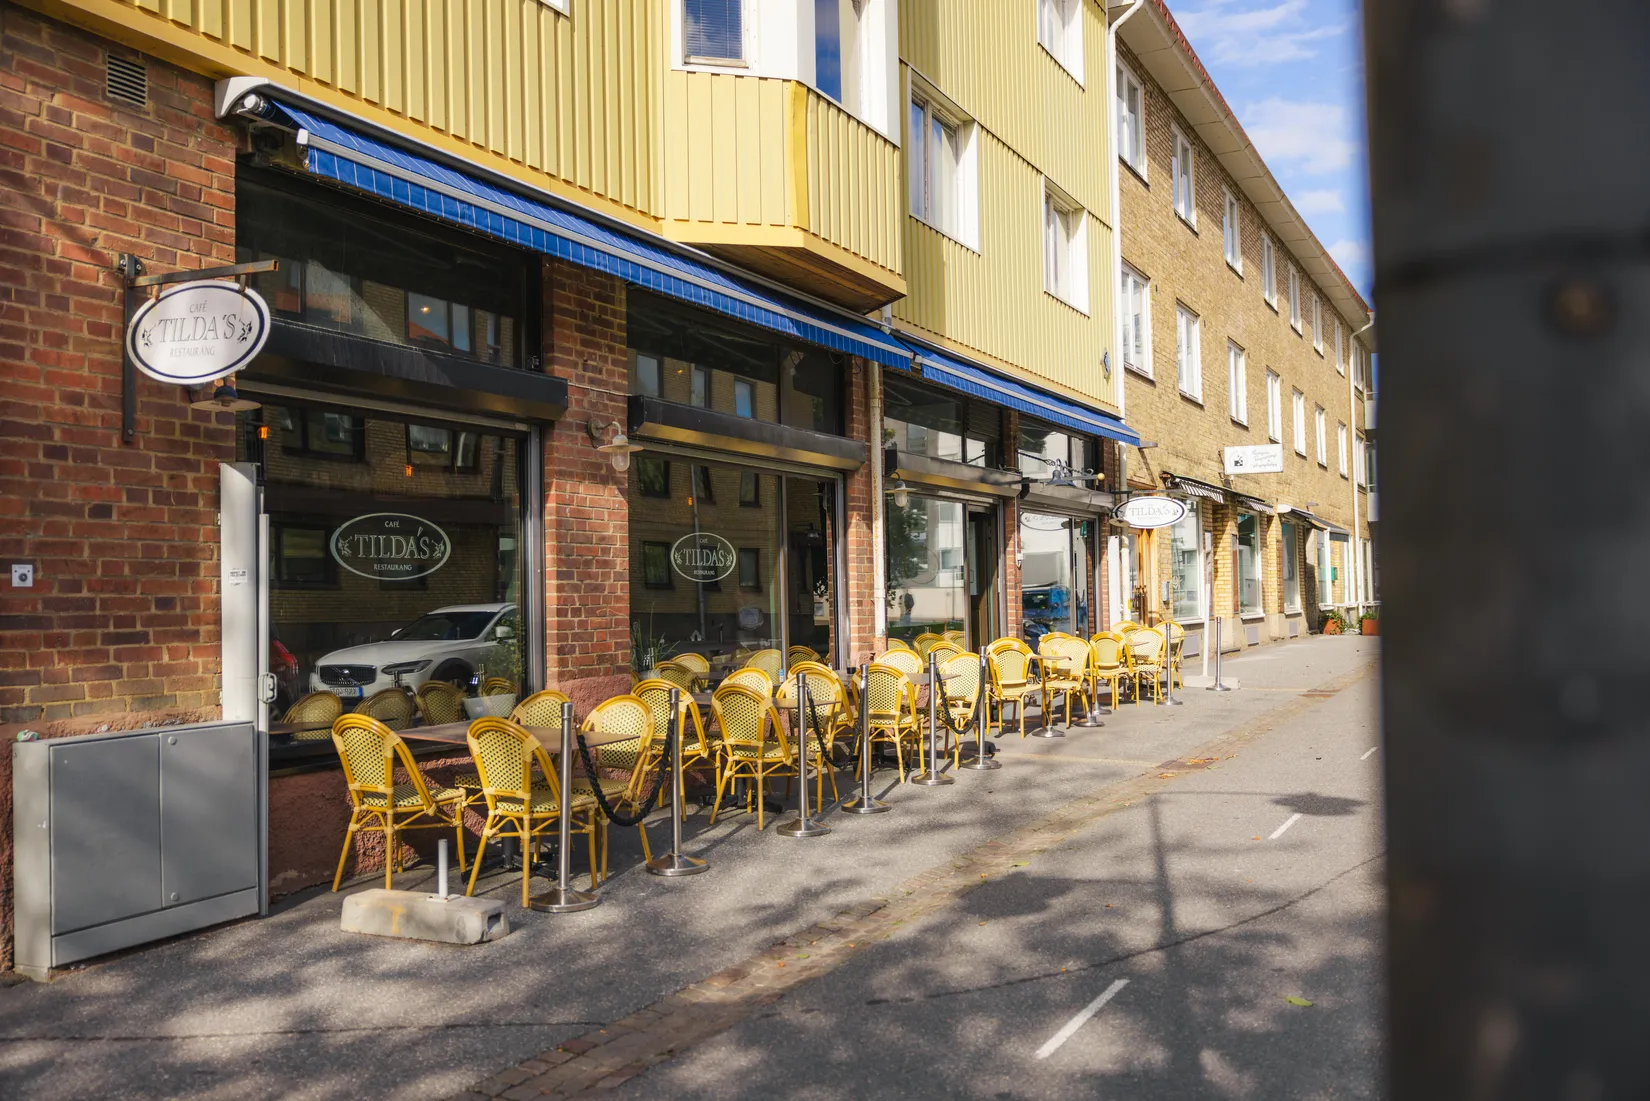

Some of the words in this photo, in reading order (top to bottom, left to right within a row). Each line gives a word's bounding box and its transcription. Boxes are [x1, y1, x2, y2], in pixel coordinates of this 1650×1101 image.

[158, 313, 238, 344] TILDA'S
[354, 526, 430, 560] TILDA'S
[682, 542, 725, 567] TILDA'S
[373, 563, 413, 571] RESTAURANG
